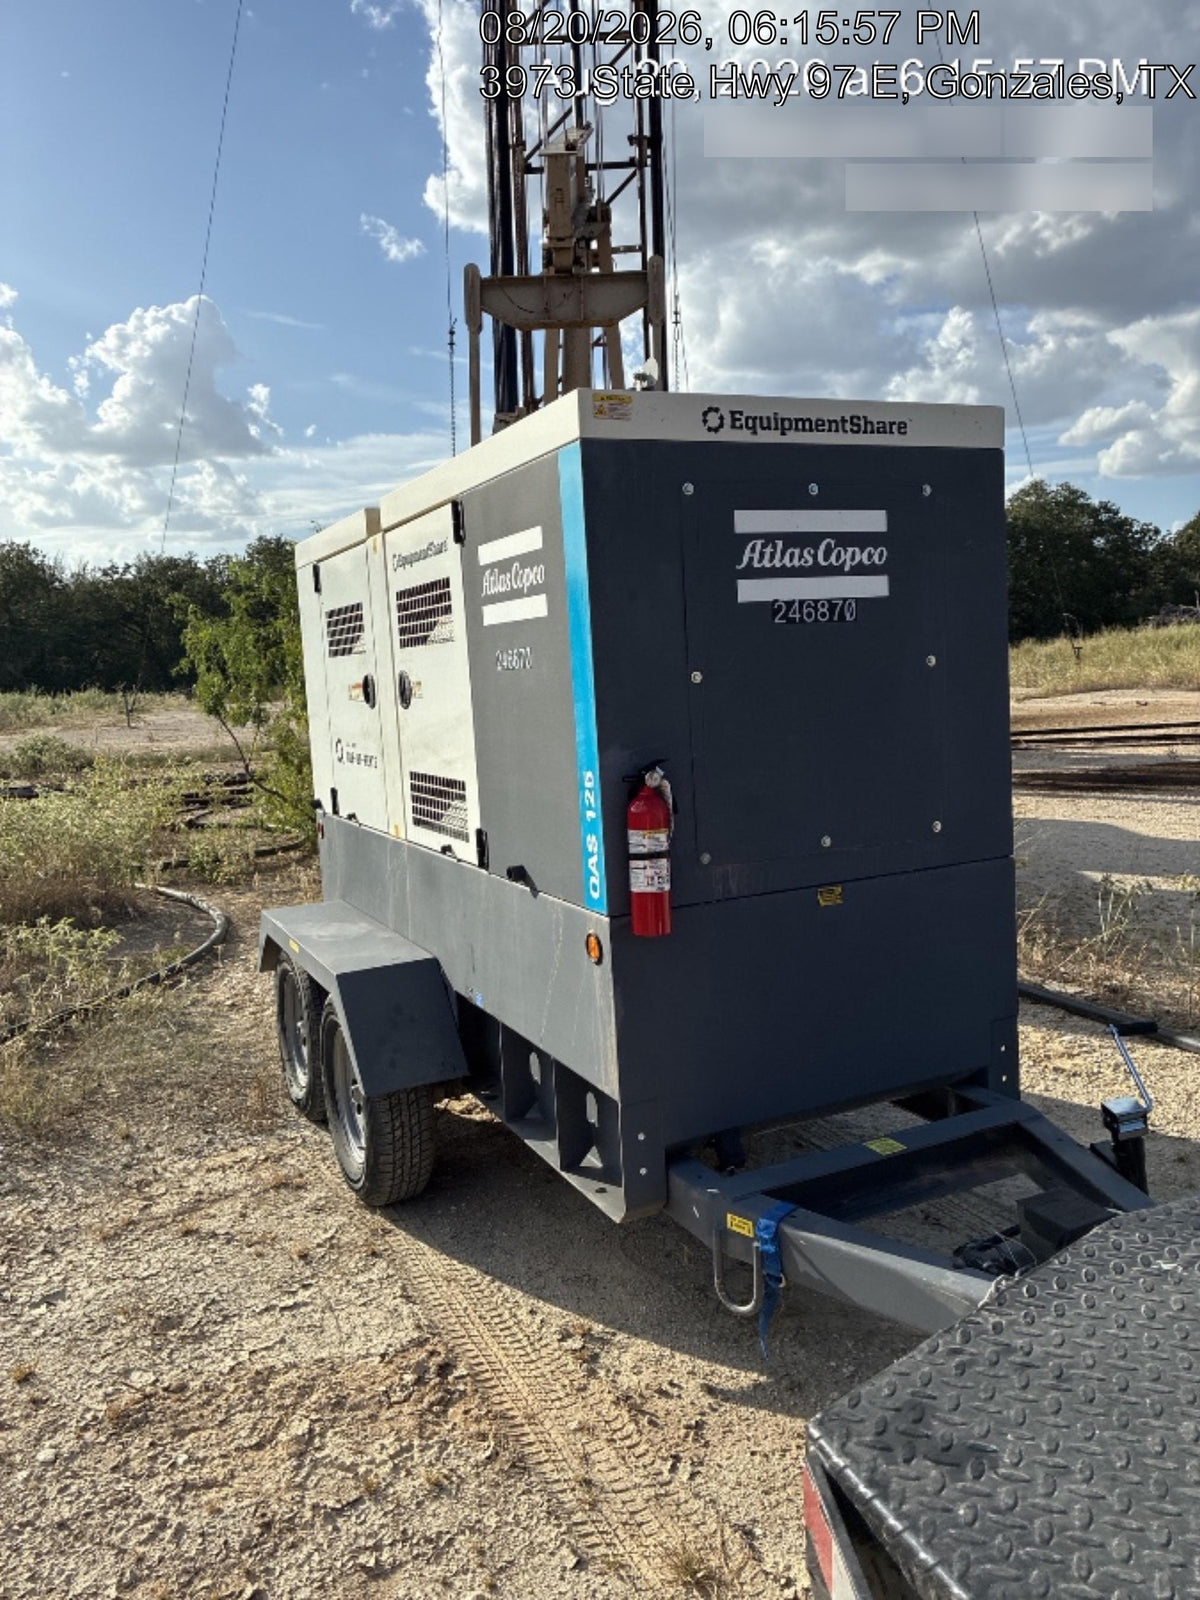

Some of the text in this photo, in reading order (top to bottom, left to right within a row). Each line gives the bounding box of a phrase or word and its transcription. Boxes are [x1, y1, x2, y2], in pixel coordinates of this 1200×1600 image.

[729, 410, 908, 436] EquipmentShare
[736, 538, 888, 572] Atlas Copco
[481, 561, 545, 597] Atlas Copco
[774, 599, 857, 623] 246870
